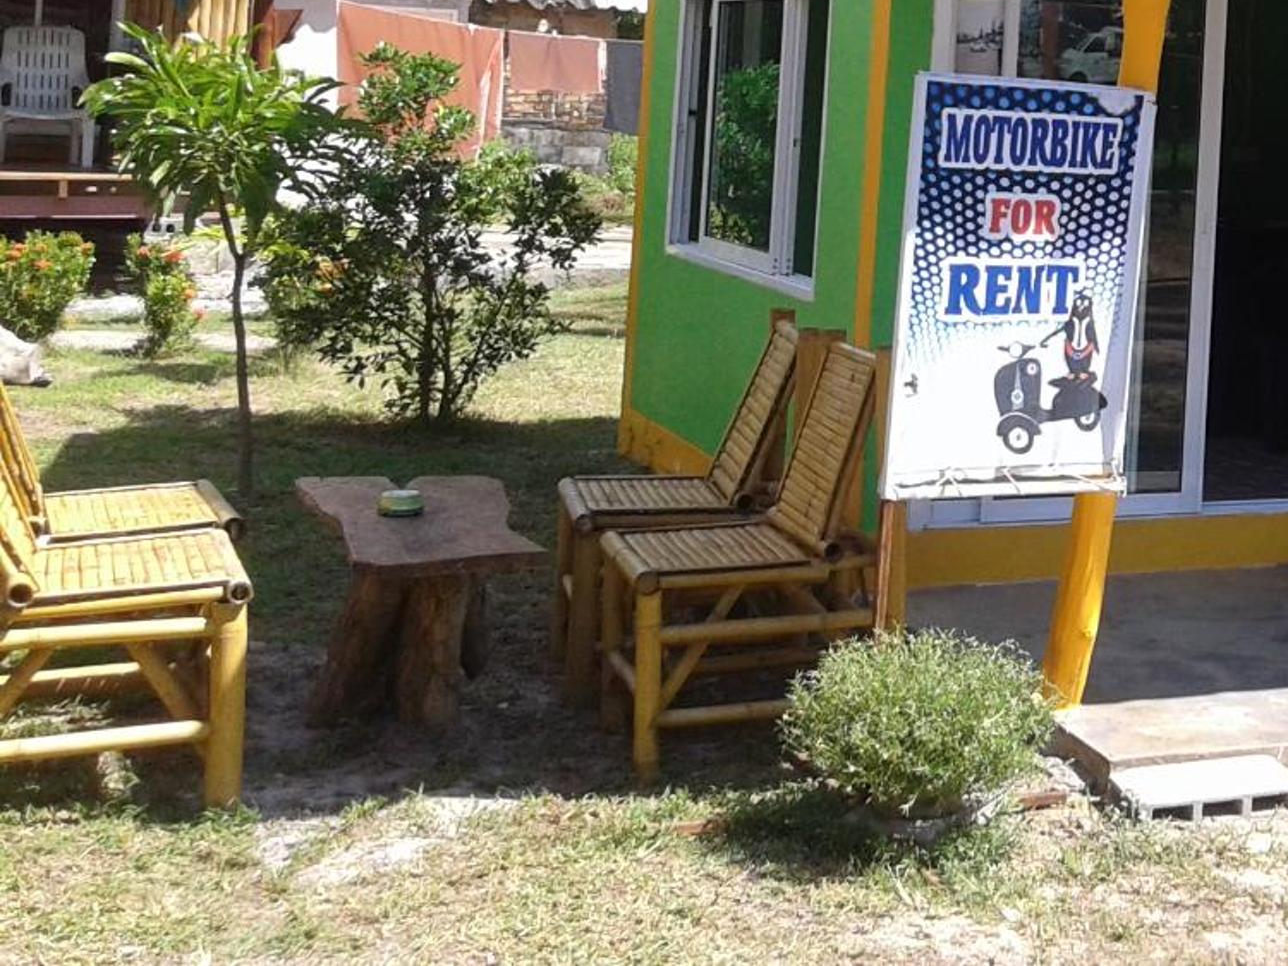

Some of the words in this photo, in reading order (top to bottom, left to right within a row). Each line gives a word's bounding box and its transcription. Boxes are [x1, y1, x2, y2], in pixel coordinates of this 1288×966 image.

[943, 113, 1119, 170] MOTORBIKE
[988, 197, 1058, 236] FOR
[944, 263, 1079, 316] RENT
